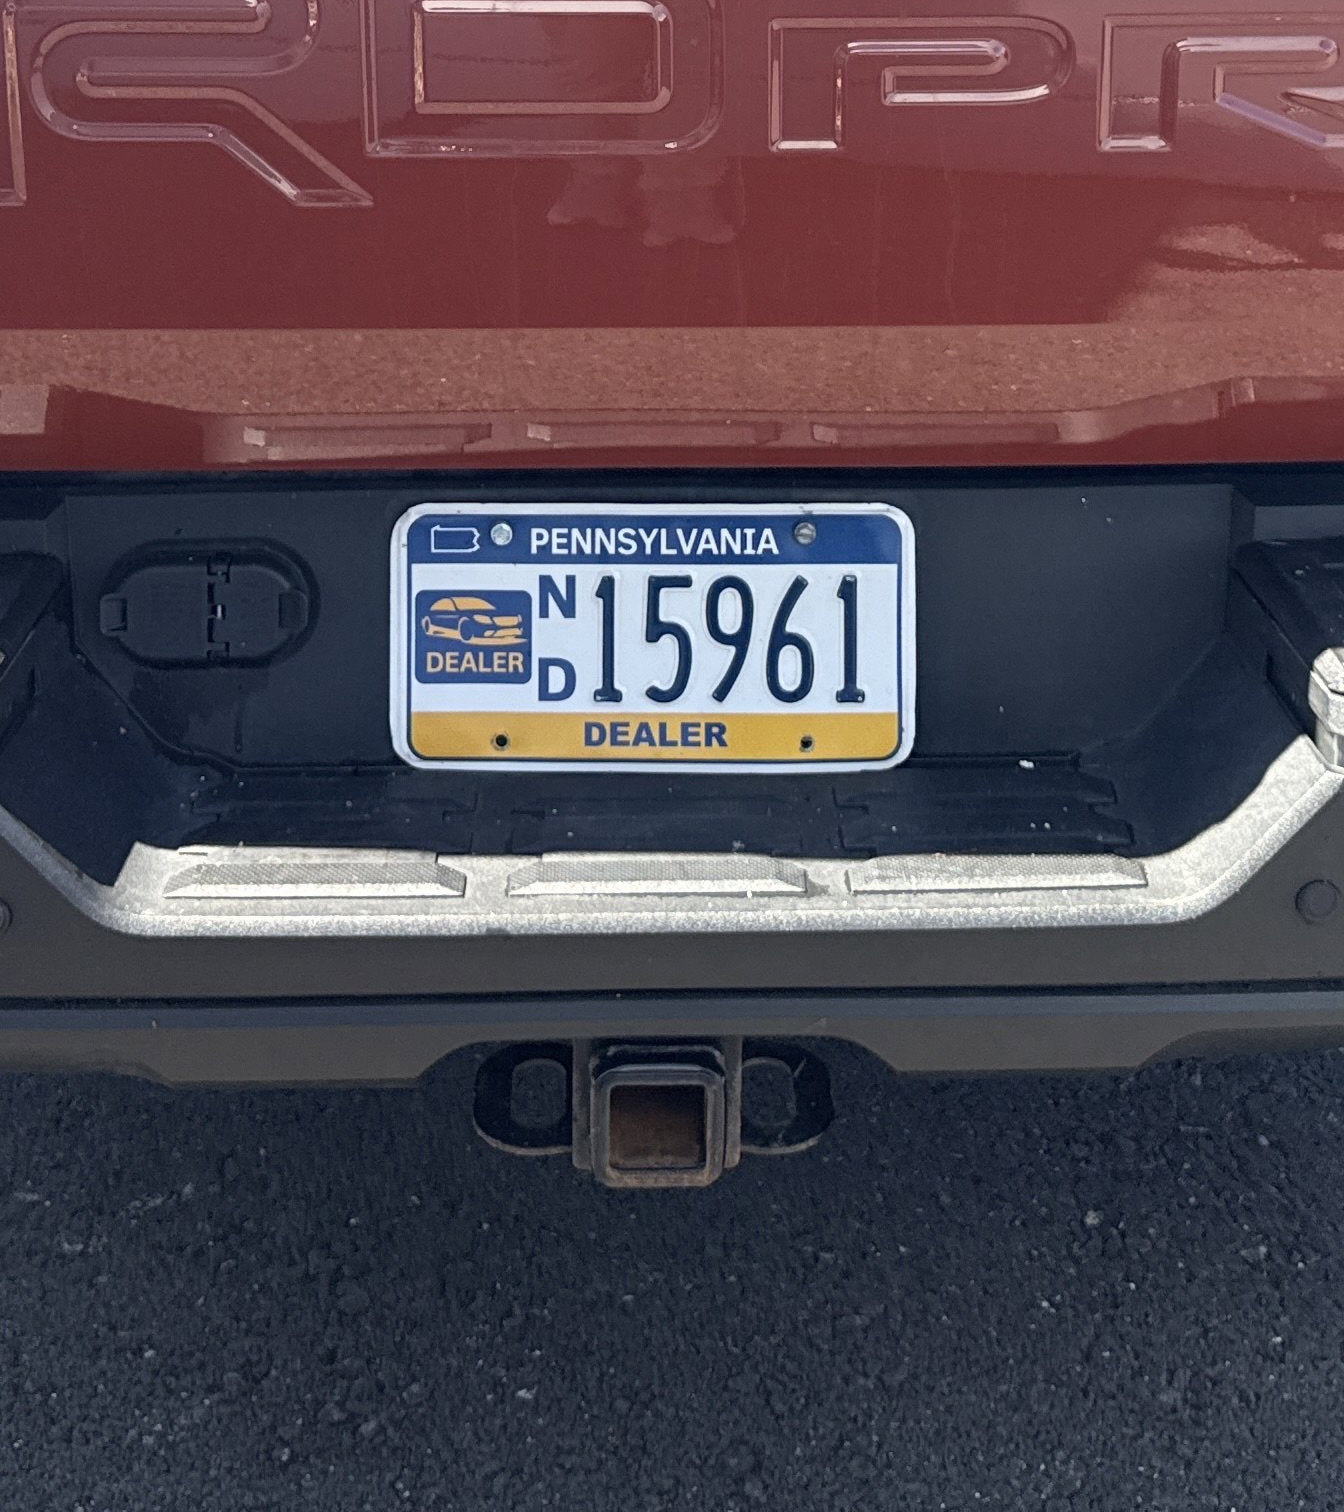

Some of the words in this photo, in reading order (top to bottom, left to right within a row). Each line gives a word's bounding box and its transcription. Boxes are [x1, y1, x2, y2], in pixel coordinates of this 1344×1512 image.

[530, 527, 779, 555] PENNSYLVANIA
[592, 574, 866, 703] 15961
[425, 651, 524, 673] DEALER
[583, 721, 728, 748] DEALER
